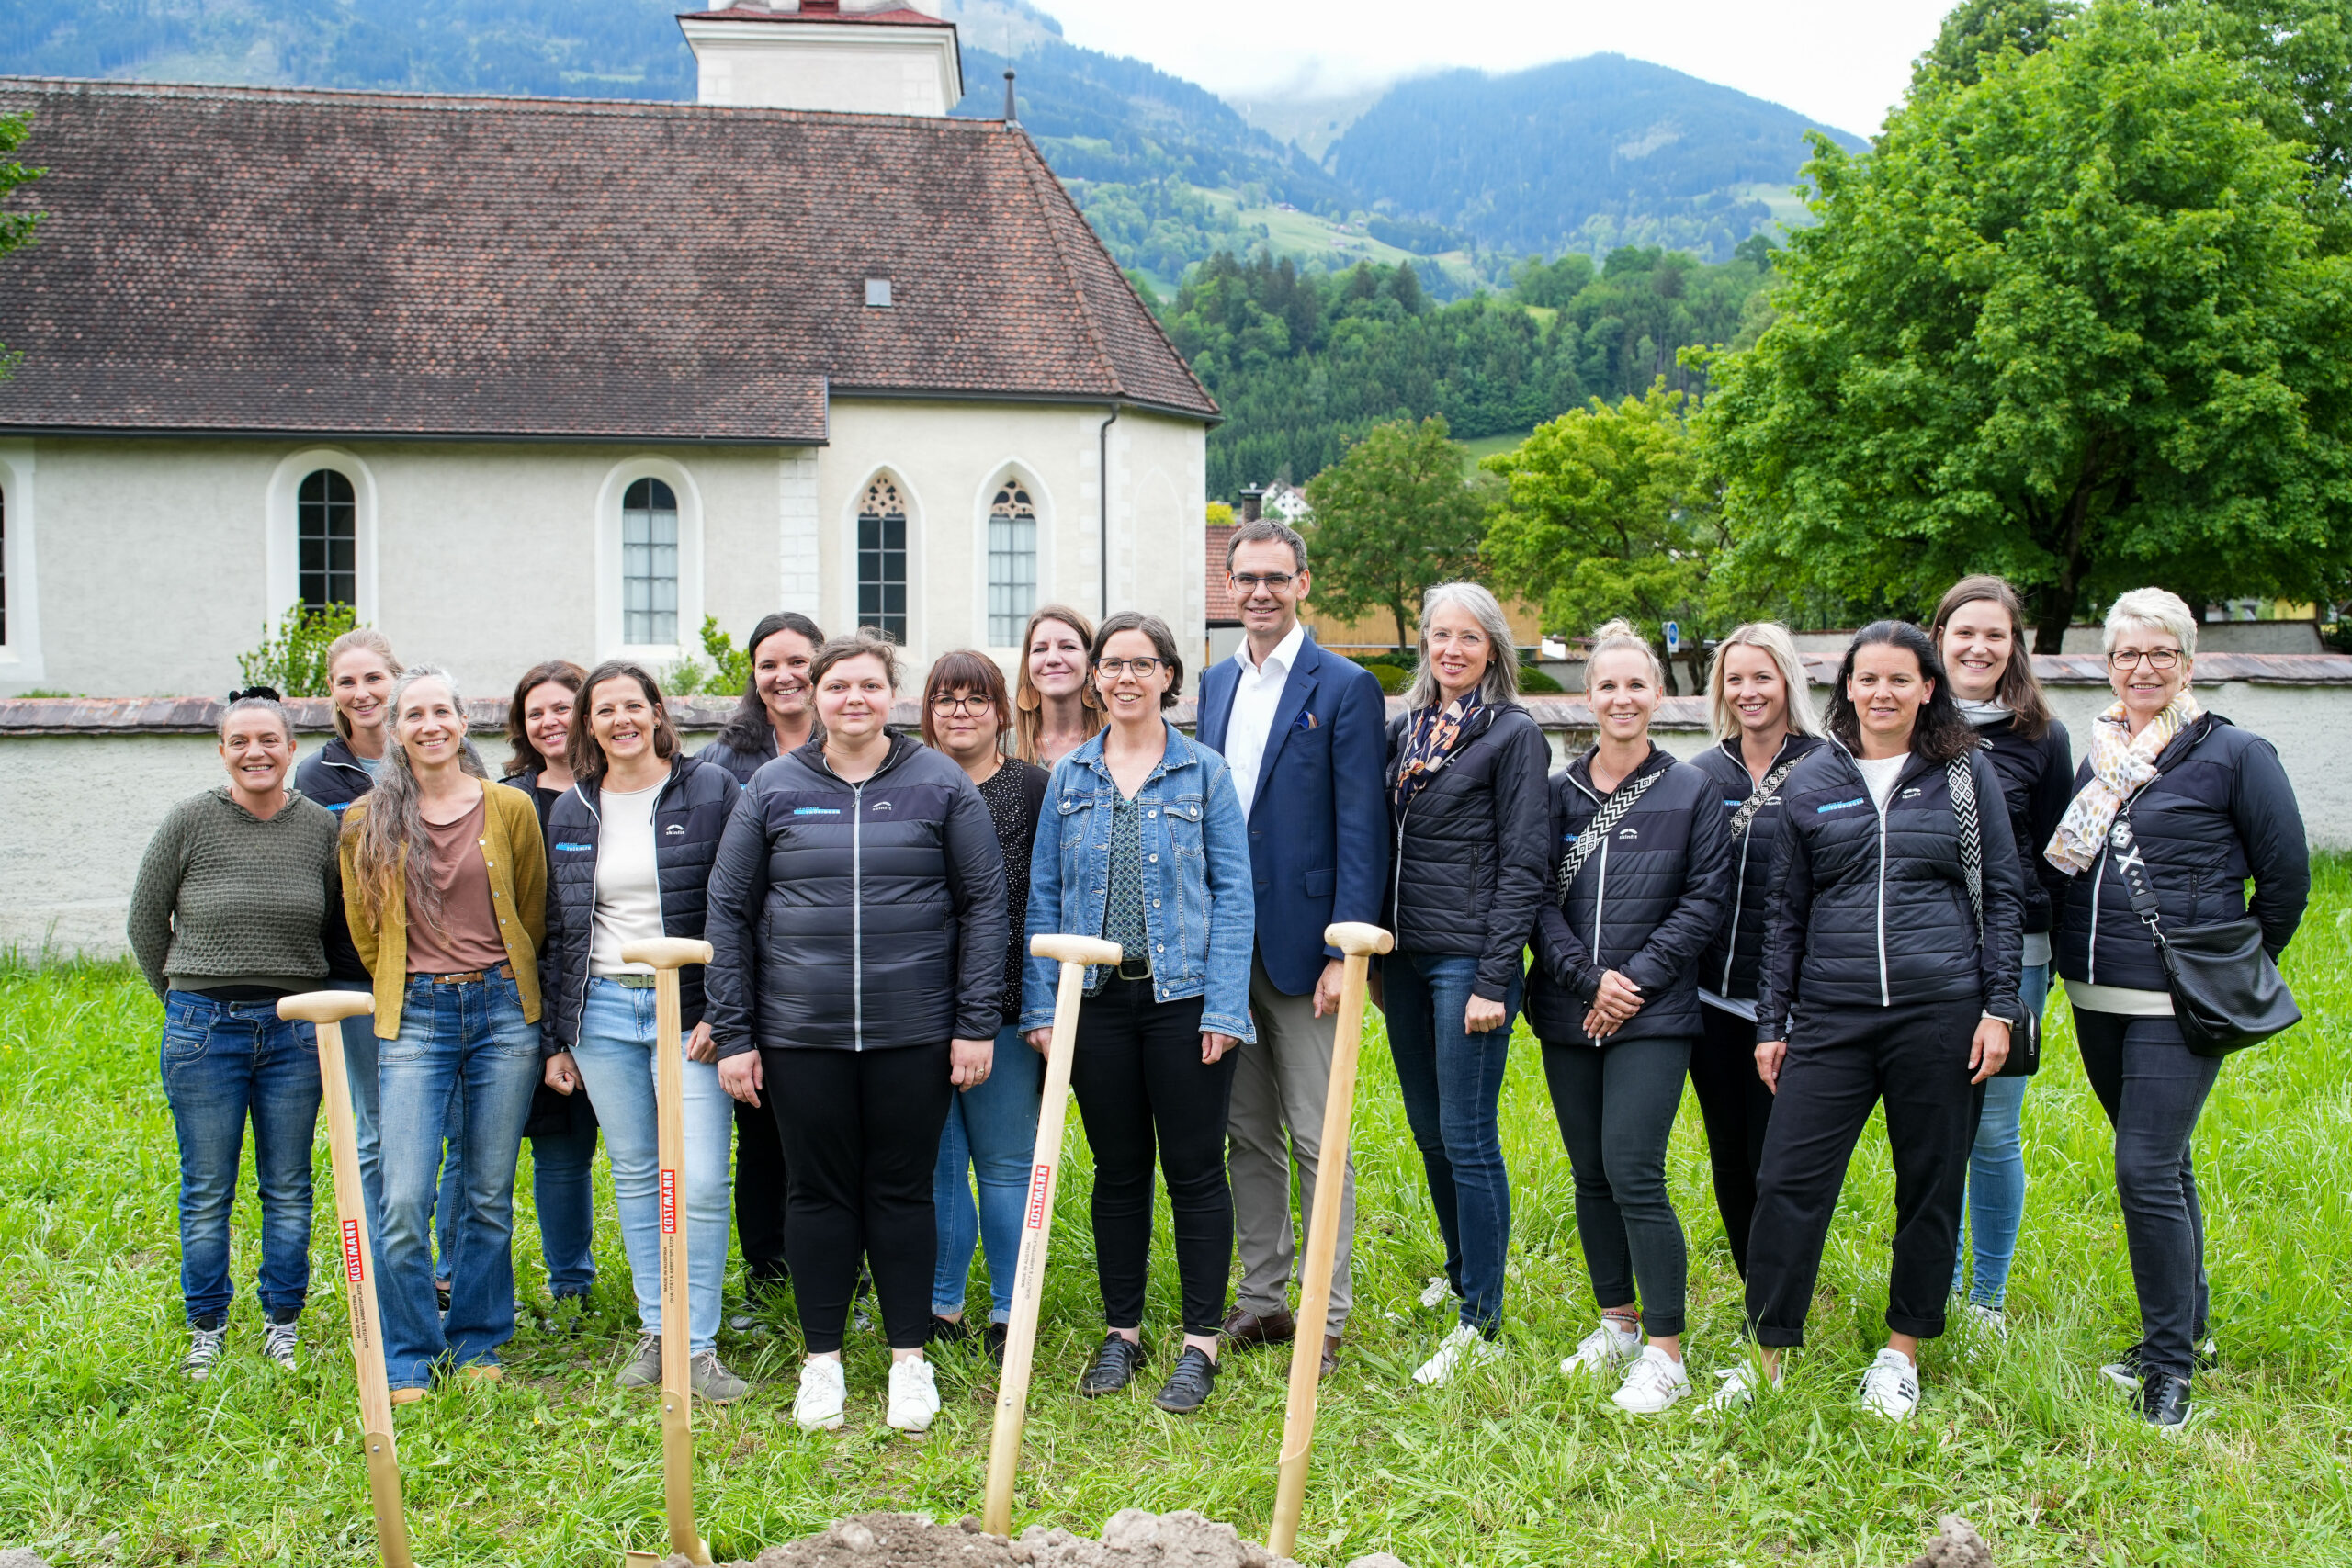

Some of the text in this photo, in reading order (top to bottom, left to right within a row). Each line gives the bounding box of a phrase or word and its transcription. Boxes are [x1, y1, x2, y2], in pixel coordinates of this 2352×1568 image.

[663, 1171, 673, 1232] KOSTMANN
[1029, 1167, 1048, 1227] KOSTMANN
[345, 1221, 362, 1280] KOSTMANN
